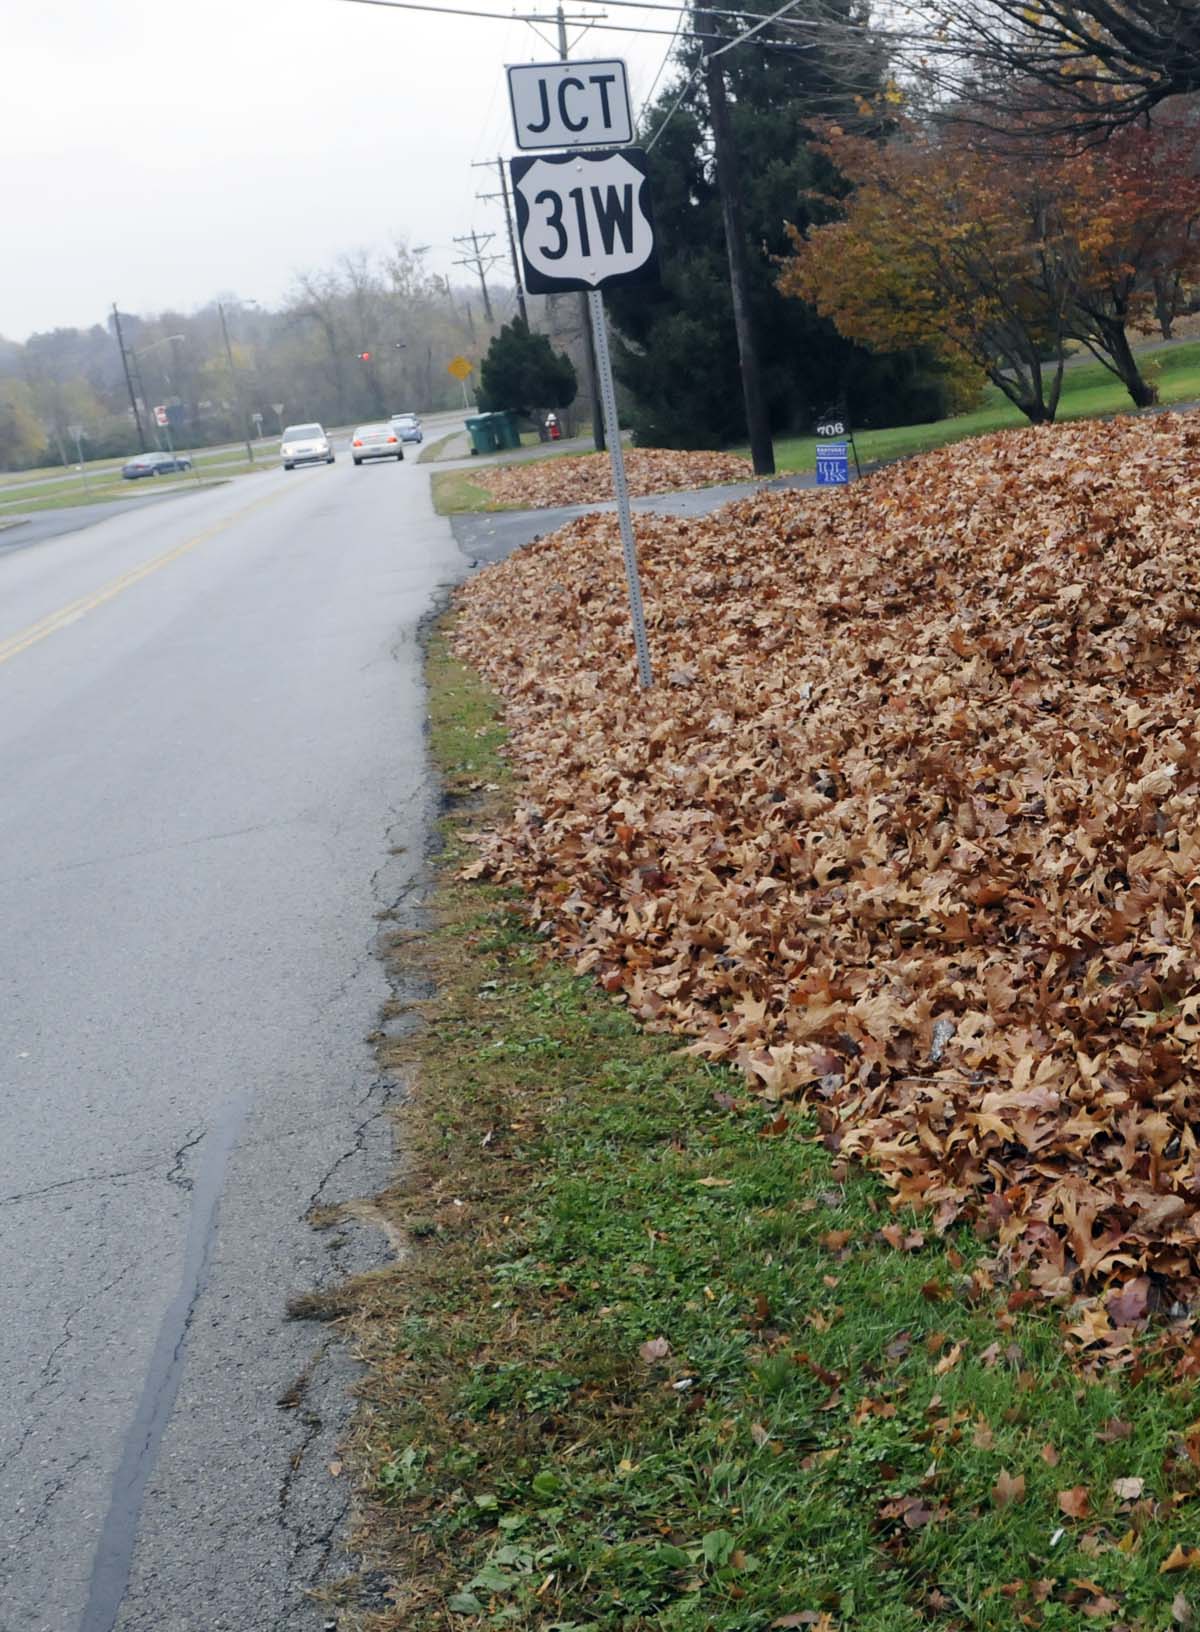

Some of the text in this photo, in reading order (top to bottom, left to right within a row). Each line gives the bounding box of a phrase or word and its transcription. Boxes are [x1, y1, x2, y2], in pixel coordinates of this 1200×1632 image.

[527, 75, 615, 133] JCT
[535, 184, 633, 260] 31W
[817, 422, 844, 435] 706
